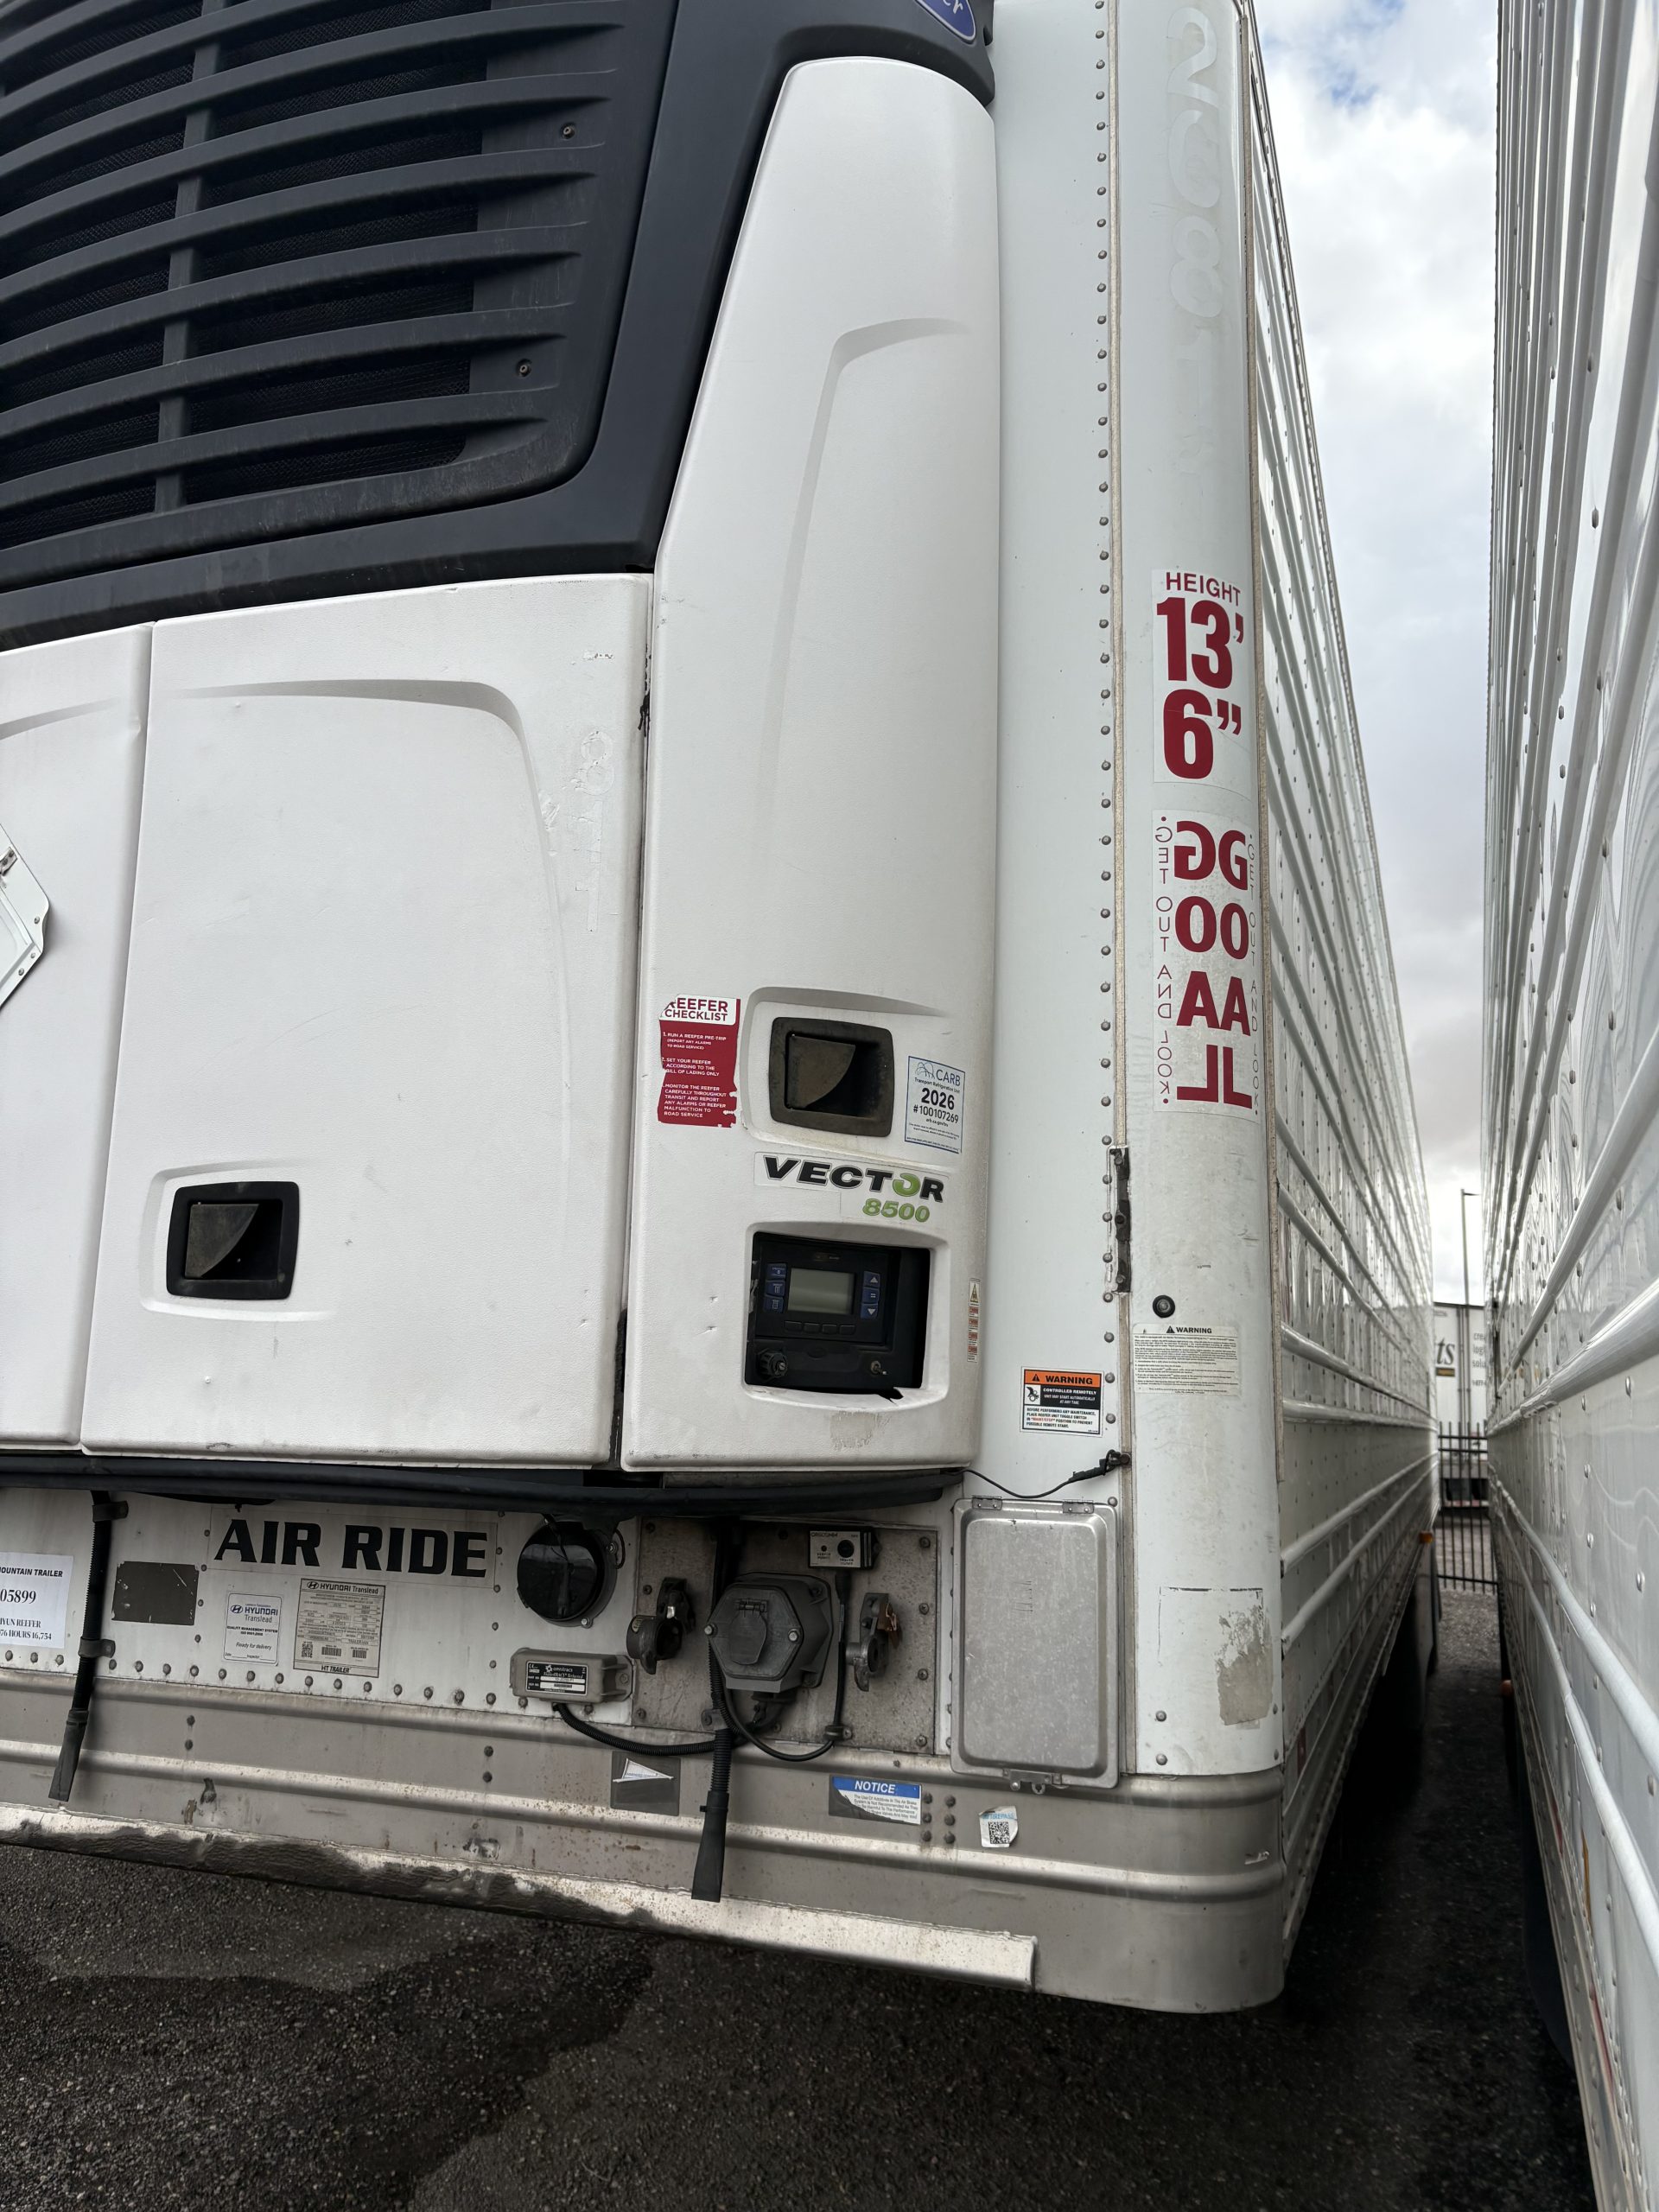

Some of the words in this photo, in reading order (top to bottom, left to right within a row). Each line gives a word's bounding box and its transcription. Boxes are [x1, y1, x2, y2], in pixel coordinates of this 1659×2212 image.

[1166, 571, 1241, 607] HEIGHT
[1156, 596, 1243, 690] 13'
[1217, 830, 1253, 1109] GOAL
[664, 1009, 728, 1021] CHECKLIST
[936, 1069, 961, 1086] CARB
[921, 1088, 955, 1110] 2026
[913, 1104, 958, 1123] #100107269
[762, 1154, 944, 1203] VECTOR
[861, 1198, 931, 1223] 8500
[1046, 1376, 1093, 1384] WARNING
[213, 1519, 321, 1567] AIR
[341, 1524, 487, 1578] RIDE
[0, 1567, 33, 1576] OUNTAIN
[34, 1569, 63, 1578] TRAILER
[320, 1583, 351, 1592] HYUNDAI
[245, 1606, 277, 1616] HYUNDAI
[245, 1614, 272, 1623] Translead
[16, 1618, 41, 1629] REEFER
[9, 1630, 31, 1638] HOURS
[855, 1780, 895, 1794] NOTICE
